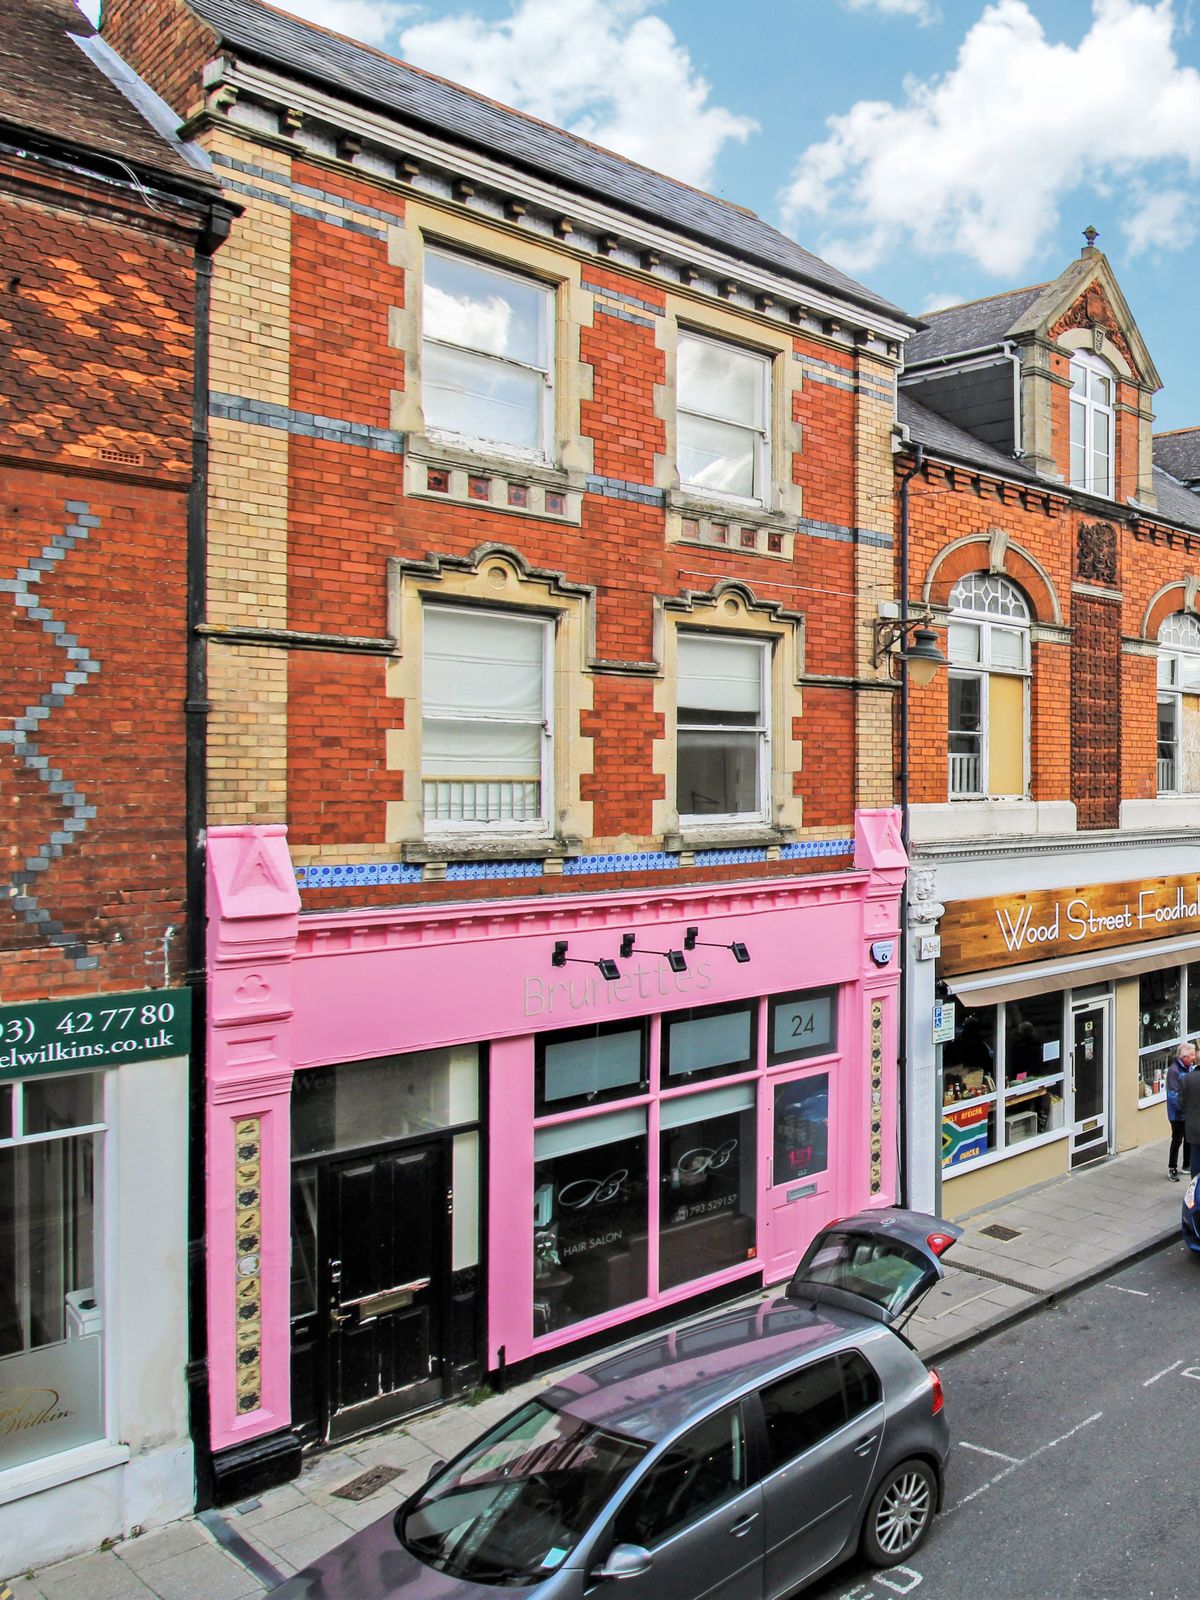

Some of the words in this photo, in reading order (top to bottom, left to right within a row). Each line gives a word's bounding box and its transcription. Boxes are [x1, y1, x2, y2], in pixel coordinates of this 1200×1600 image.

[996, 902, 1060, 952] Wood
[1067, 899, 1132, 941] Street
[524, 962, 712, 1017] Brunettes
[791, 1013, 815, 1037] 24
[563, 1242, 587, 1257] HAIR
[589, 1230, 623, 1249] SALON
